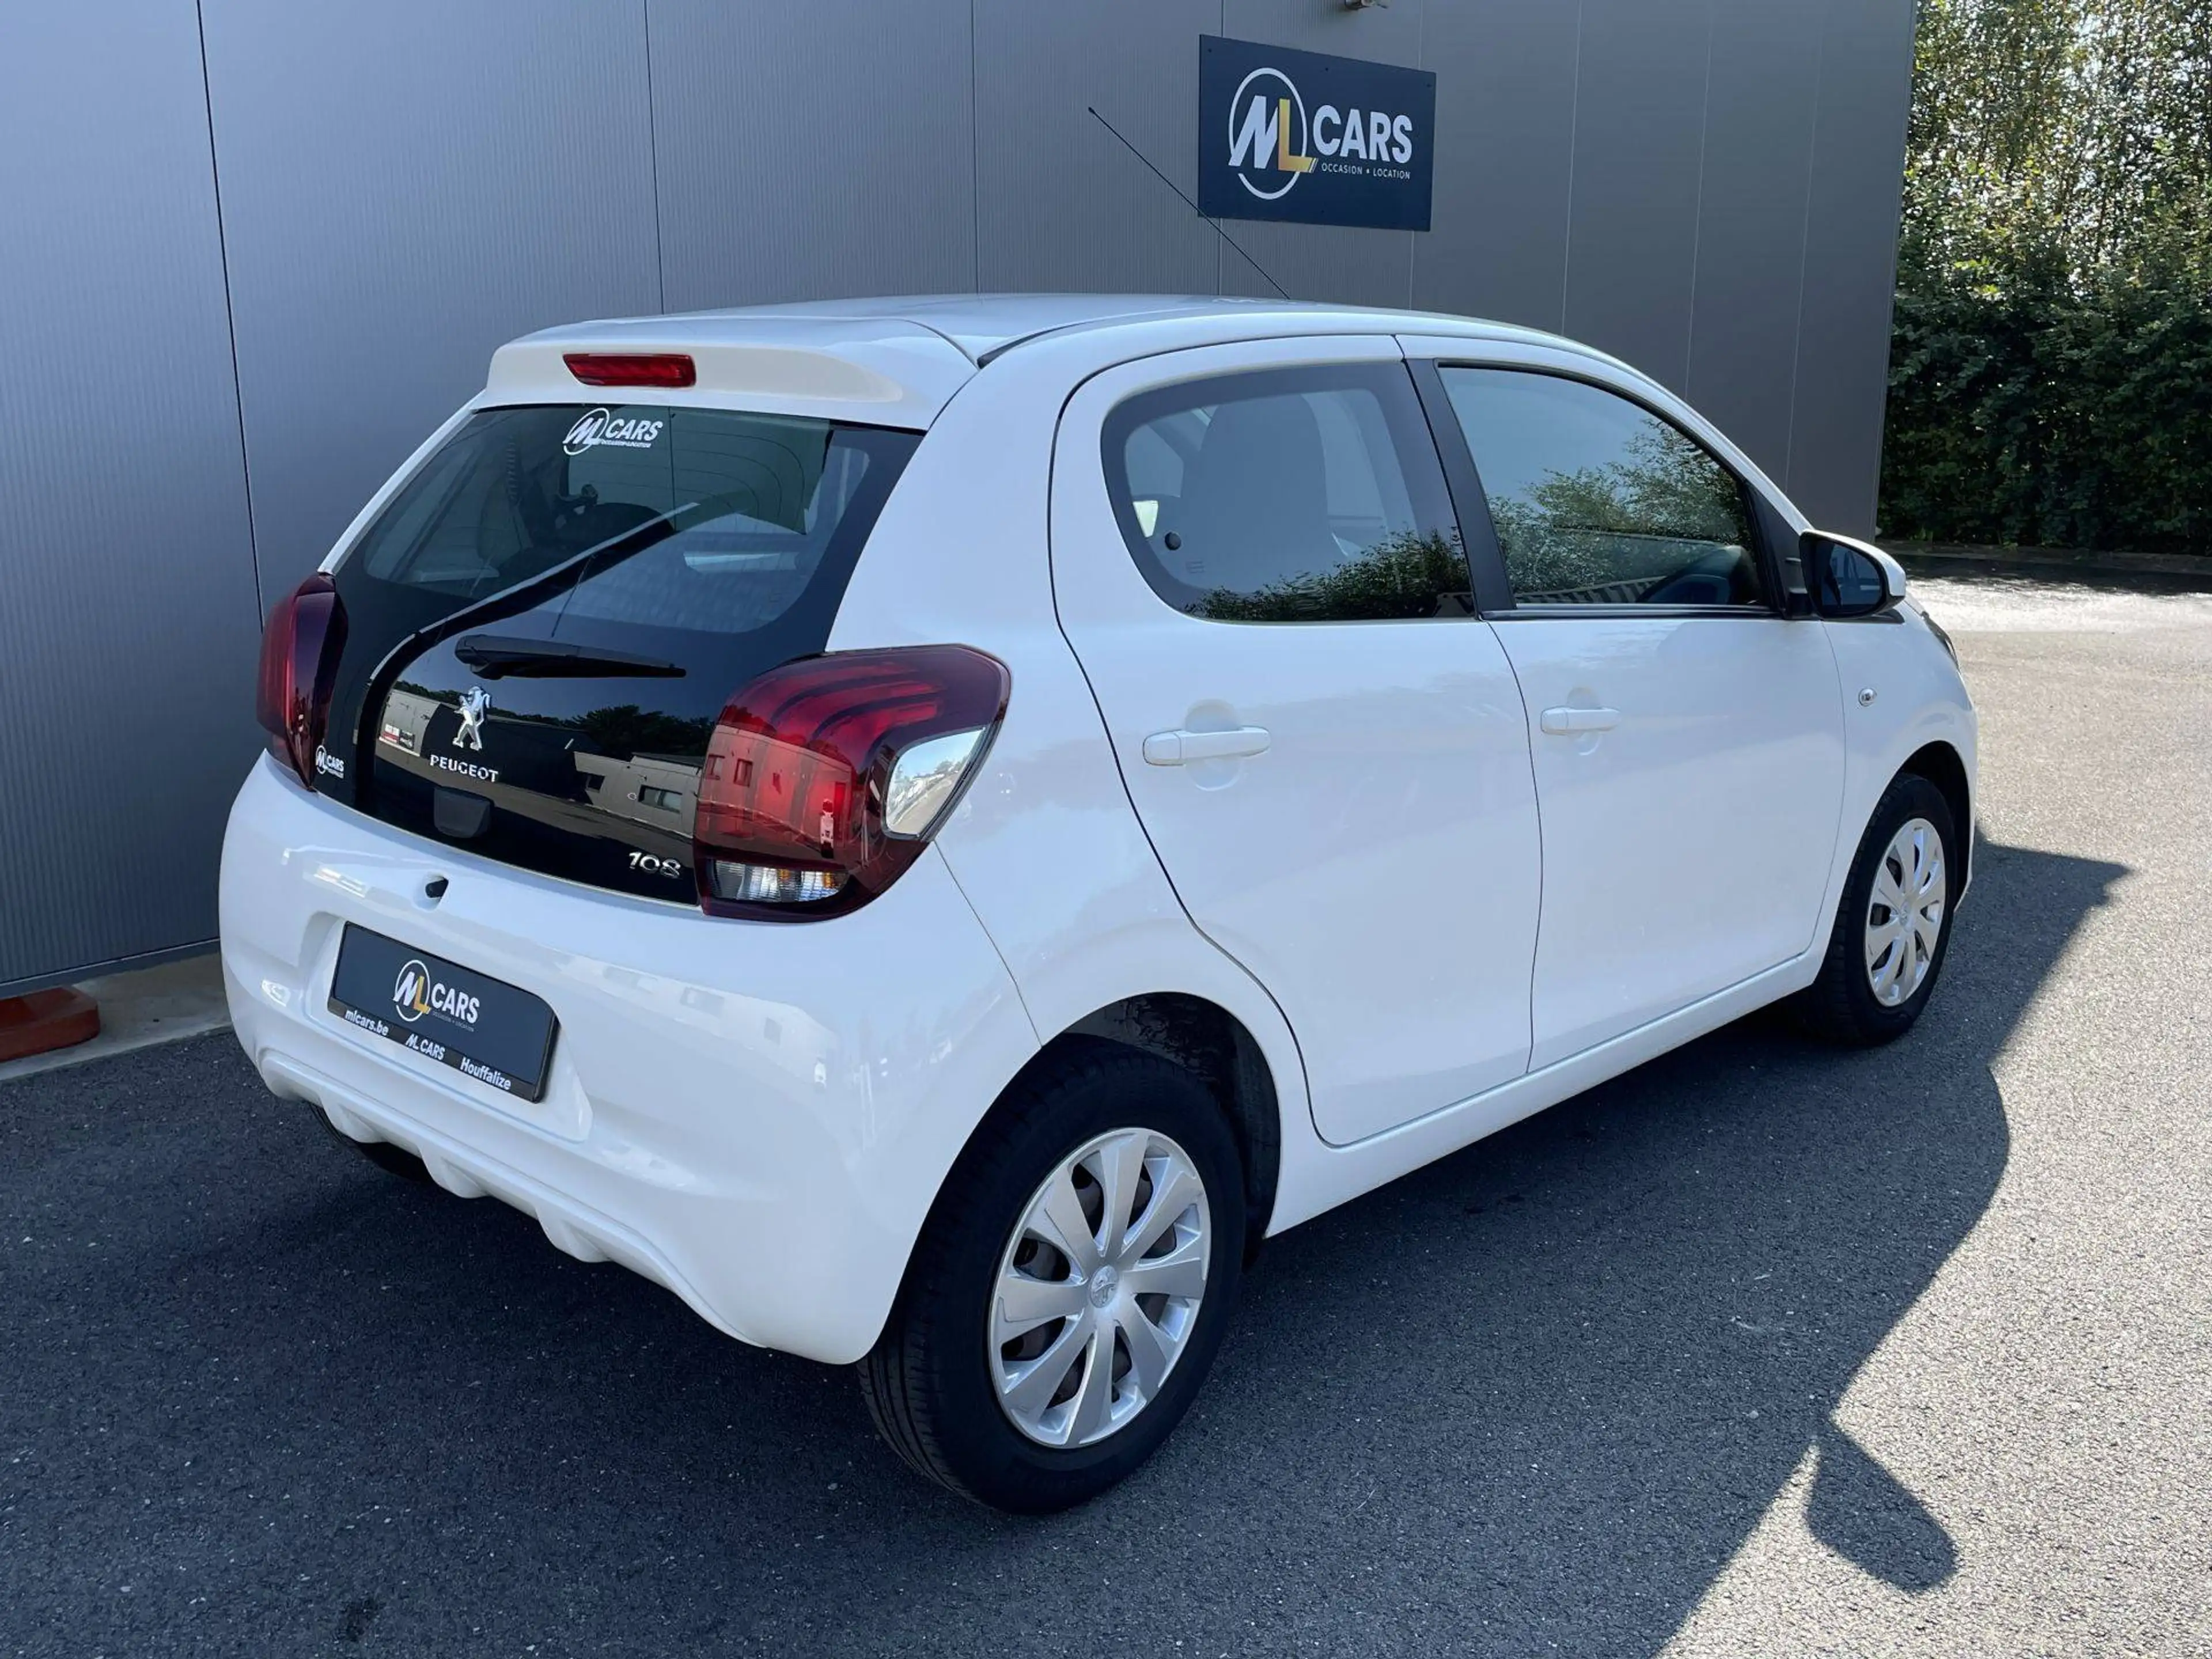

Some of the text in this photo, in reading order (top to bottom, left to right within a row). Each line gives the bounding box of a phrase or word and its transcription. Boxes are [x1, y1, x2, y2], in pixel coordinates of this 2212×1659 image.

[1228, 95, 1412, 173] ML CARS
[1321, 162, 1411, 180] OCCASION LOCATION
[605, 418, 663, 441] CARS
[429, 754, 499, 783] PEUGEOT
[628, 851, 681, 879] 108
[431, 982, 480, 1024] CARS
[344, 1009, 390, 1036] mlcars.be
[419, 1038, 446, 1061] CARS
[460, 1056, 512, 1091] Houffalize
